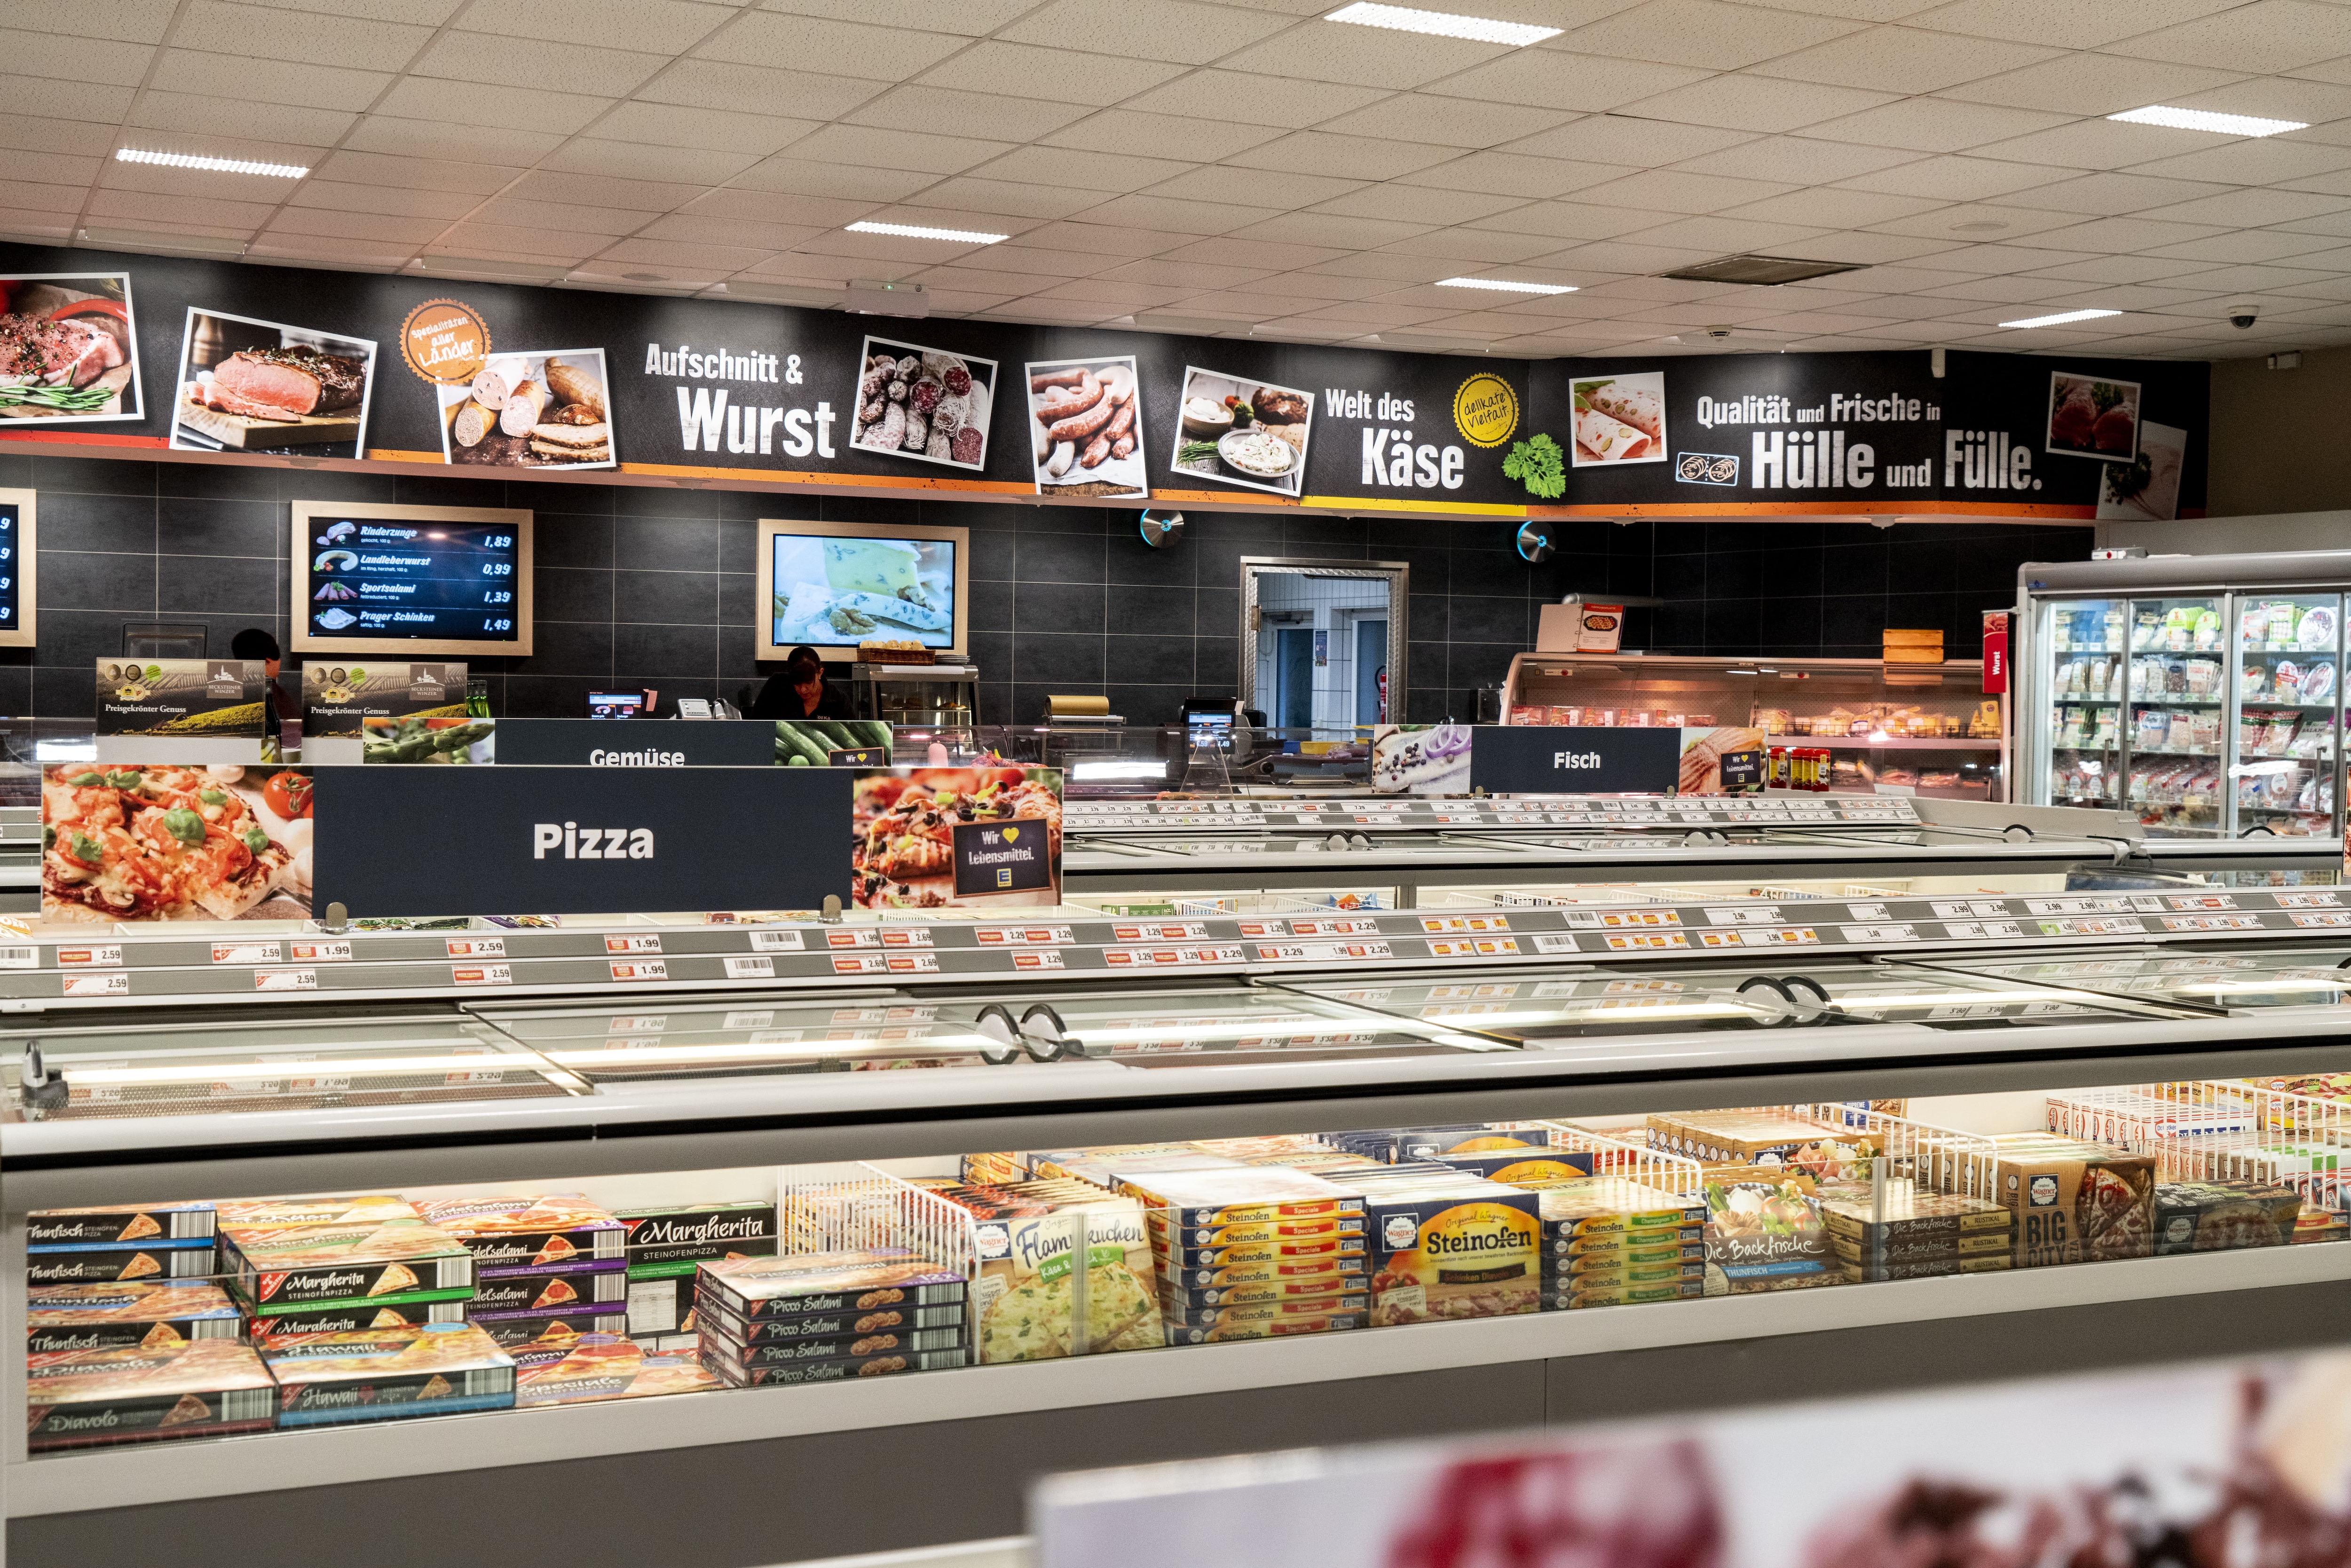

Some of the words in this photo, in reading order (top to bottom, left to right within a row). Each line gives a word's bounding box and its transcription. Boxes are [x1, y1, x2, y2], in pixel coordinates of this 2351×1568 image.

[431, 332, 455, 347] aller
[418, 339, 474, 367] Länder
[645, 343, 778, 383] Aufschnitt
[786, 355, 803, 384] &
[1325, 388, 1372, 419] Welt
[1378, 392, 1415, 422] des
[1464, 393, 1506, 416] delikate
[1697, 395, 1791, 429] Qualität
[1797, 405, 1824, 422] und
[1831, 393, 1921, 422] Frische
[1926, 403, 1941, 421] in
[677, 386, 836, 458] Wurst
[1362, 428, 1464, 489] Käse
[1752, 431, 1875, 489] Hülle
[1887, 459, 1931, 487] und
[1945, 430, 2043, 491] Fülle.
[360, 526, 417, 540] Rinderzunge
[485, 536, 512, 547] 1,89
[360, 555, 432, 566] Landleberwurst
[482, 564, 512, 575] 0,99
[360, 583, 417, 594] Sportsalami
[484, 591, 511, 603] 1,39
[360, 612, 392, 622] Prager
[393, 612, 435, 622] Schinken
[484, 619, 511, 631] 1,49
[1992, 651, 2000, 675] Wurst
[105, 704, 158, 714] Preisgekrönter
[311, 706, 362, 716] Preisgekrönter
[590, 748, 685, 767] Gemüse
[1554, 751, 1601, 769] Fisch
[534, 822, 654, 859] Pizza
[981, 830, 1000, 844] Wir
[969, 847, 1034, 865] Lebensmittel.
[102, 951, 120, 959] 2.59
[262, 949, 279, 957] 2.59
[325, 946, 349, 955] 1.99
[297, 975, 315, 984] 2.59
[492, 969, 509, 978] 2.59
[1506, 1168, 1535, 1182] Original
[1226, 1212, 1270, 1222] Steinofen
[1894, 1222, 1908, 1234] Die
[1974, 1215, 2001, 1223] RUSTIKAL
[640, 1215, 763, 1246] Margherita
[1387, 1229, 1415, 1238] Wagner
[1585, 1223, 1624, 1233] Steinofen
[2027, 1211, 2066, 1249] BIG
[1226, 1232, 1269, 1243] Steinofen
[1427, 1226, 1532, 1255] Steinofen
[469, 1243, 528, 1259] delsalami
[644, 1247, 717, 1260] STEINOFENPIZZA
[1228, 1252, 1271, 1263] Steinofen
[1705, 1241, 1727, 1262] Die
[2028, 1245, 2067, 1267] CITY
[2070, 1239, 2079, 1262] IZZA
[1040, 1263, 1062, 1277] Käse
[1726, 1267, 1768, 1277] THUNFISCH
[262, 1274, 272, 1285] GUT
[286, 1272, 364, 1290] Margherita
[288, 1289, 352, 1299] STEINOFENPIZZA
[770, 1300, 800, 1315] Picco
[803, 1295, 842, 1312] Salami
[767, 1323, 800, 1337] Picco
[802, 1318, 840, 1335] Salami
[30, 1333, 99, 1351] Thunfisch
[763, 1346, 795, 1361] Picco
[797, 1342, 836, 1358] Salami
[302, 1387, 358, 1408] Hawaii
[47, 1410, 118, 1432] Diavolo
